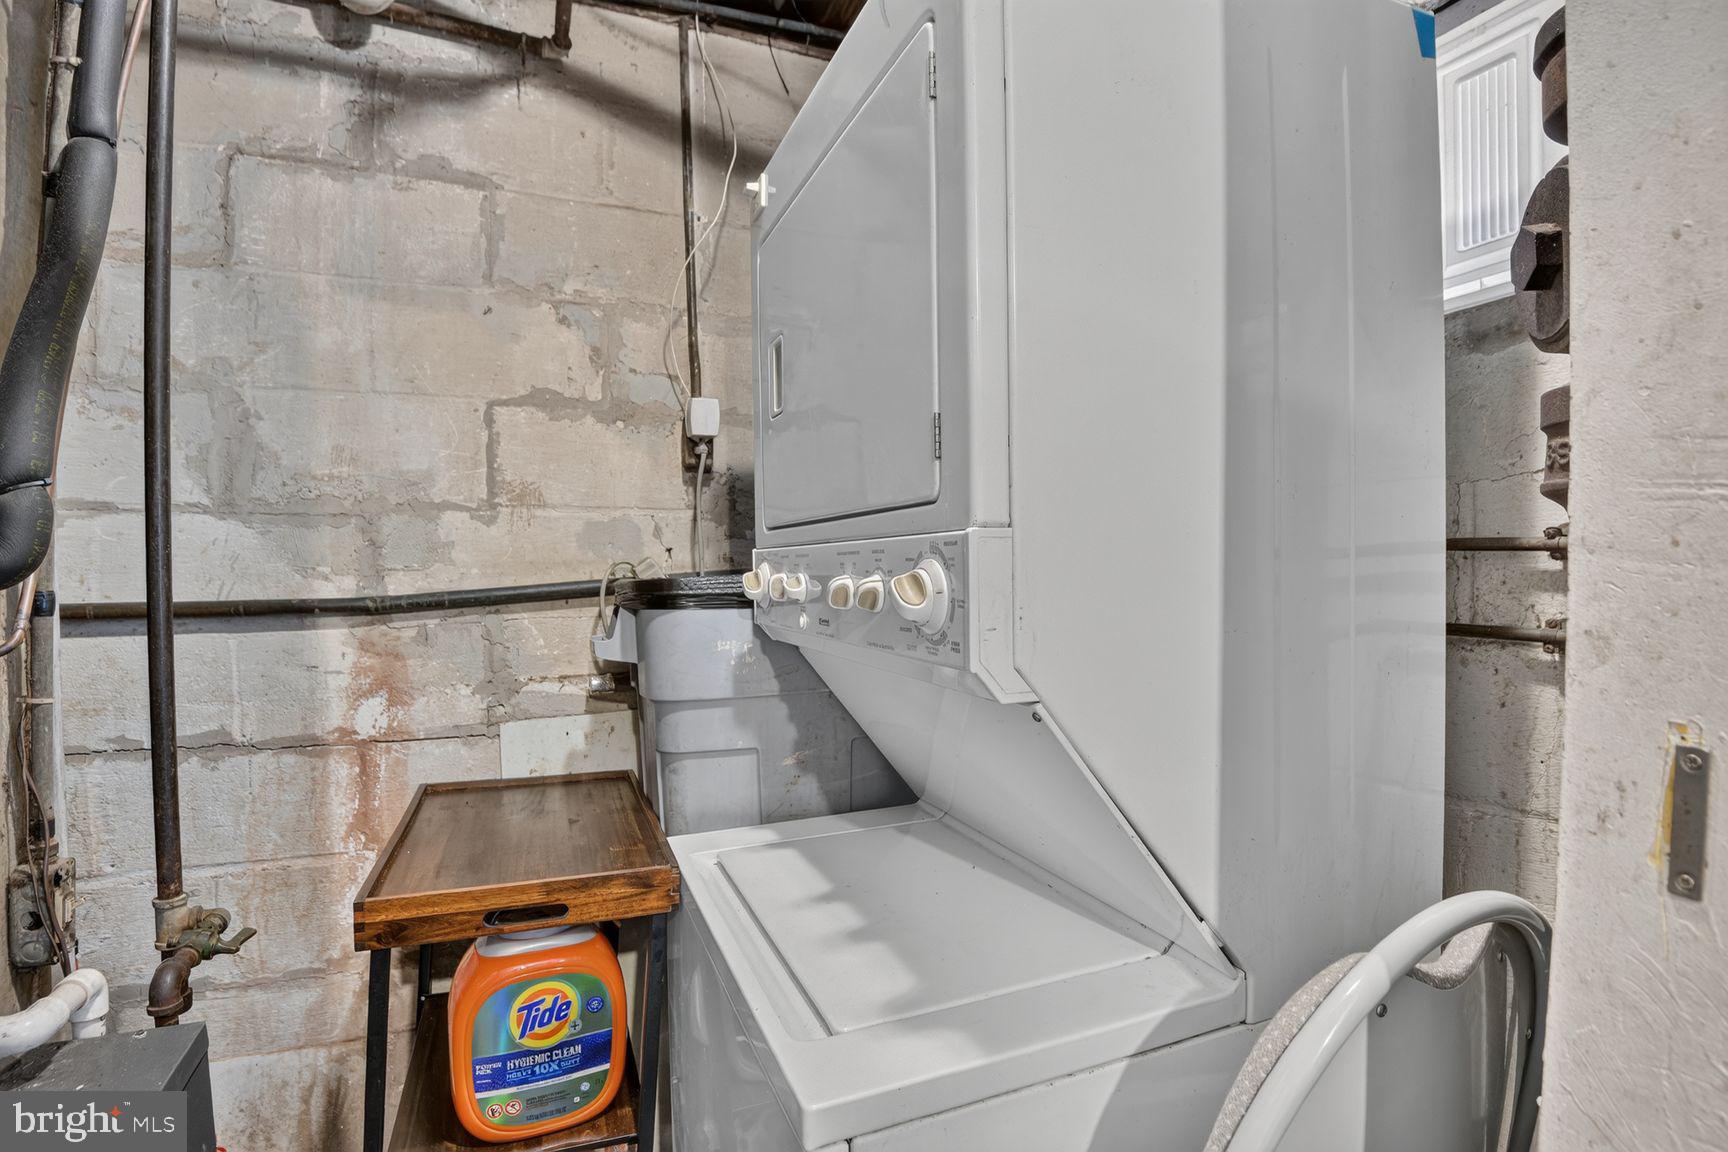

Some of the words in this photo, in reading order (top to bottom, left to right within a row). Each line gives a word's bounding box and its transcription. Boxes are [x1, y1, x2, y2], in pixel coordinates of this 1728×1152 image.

[516, 993, 573, 1041] Tide
[507, 1052, 551, 1070] HYGIENIC
[552, 1044, 582, 1059] CLEAN
[533, 1060, 560, 1075] 10X
